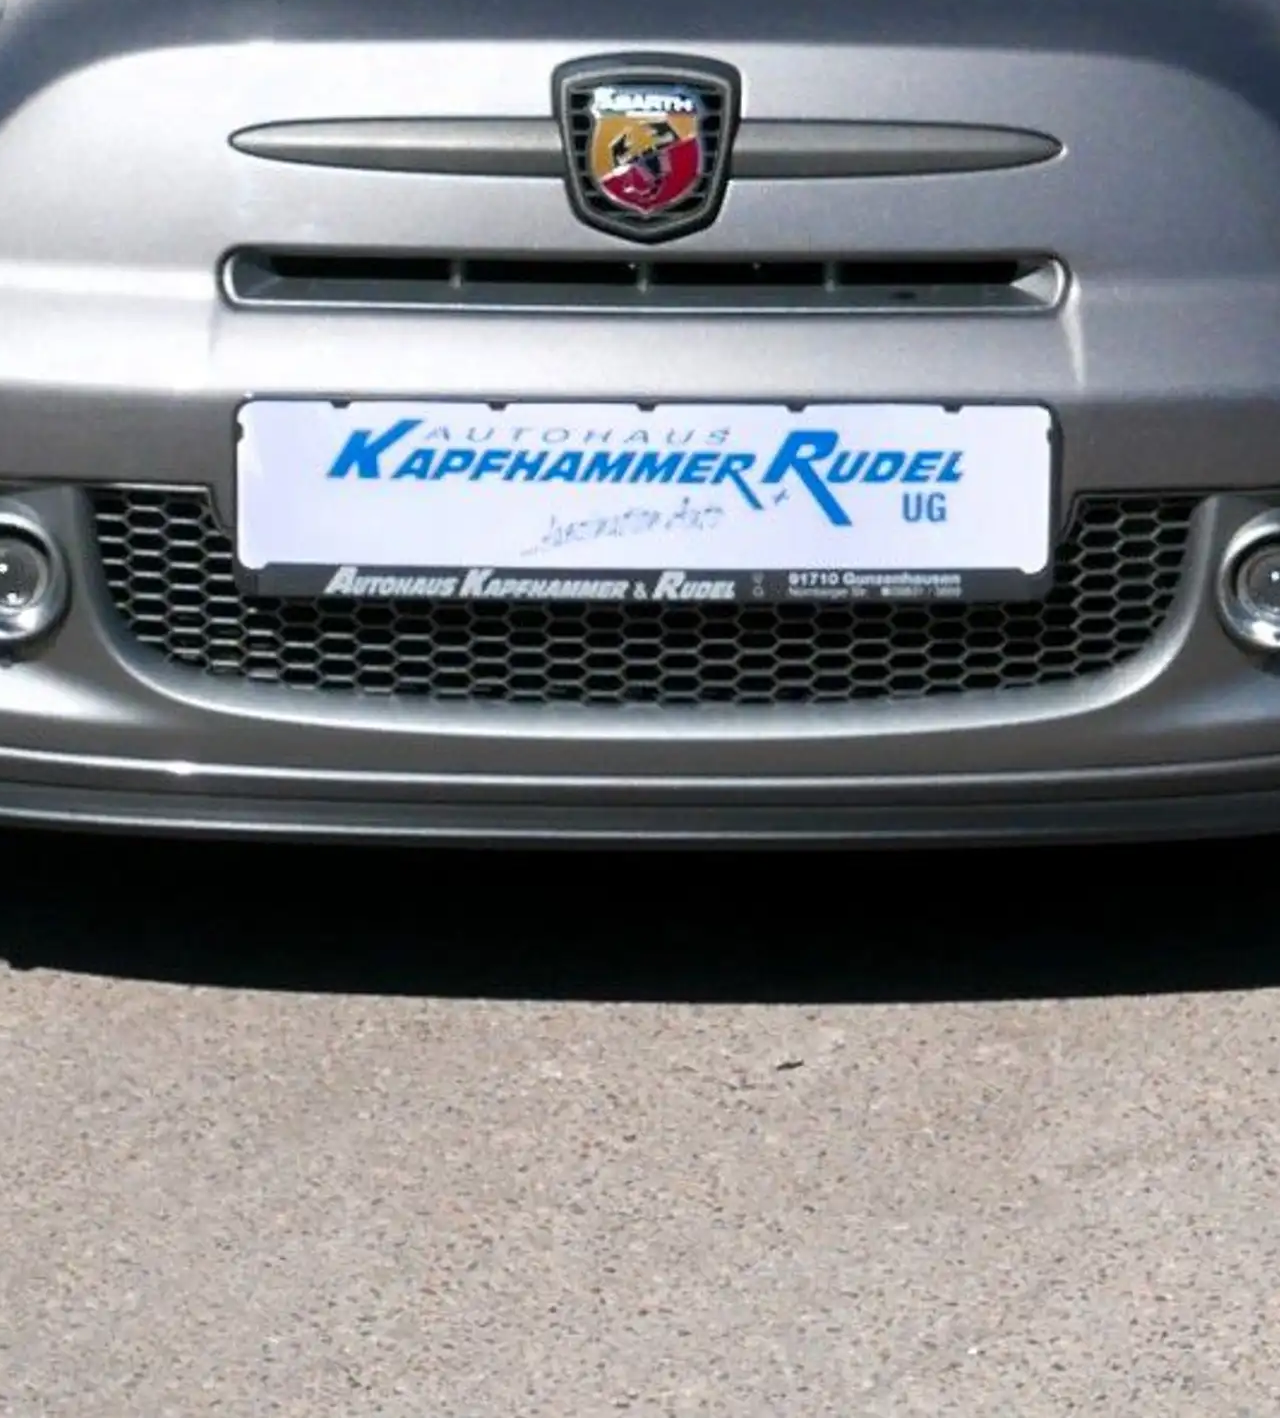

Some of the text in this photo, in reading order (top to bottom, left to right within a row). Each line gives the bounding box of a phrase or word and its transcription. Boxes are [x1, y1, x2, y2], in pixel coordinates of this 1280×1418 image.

[424, 425, 731, 445] AUTOHAUS
[326, 417, 764, 510] KAPFHAMMER
[761, 429, 965, 526] RUDEL
[901, 492, 948, 523] UG
[325, 565, 459, 596] AUTOHAUS
[459, 567, 628, 599] KAPFHAMMER
[651, 570, 737, 600] RUDEL
